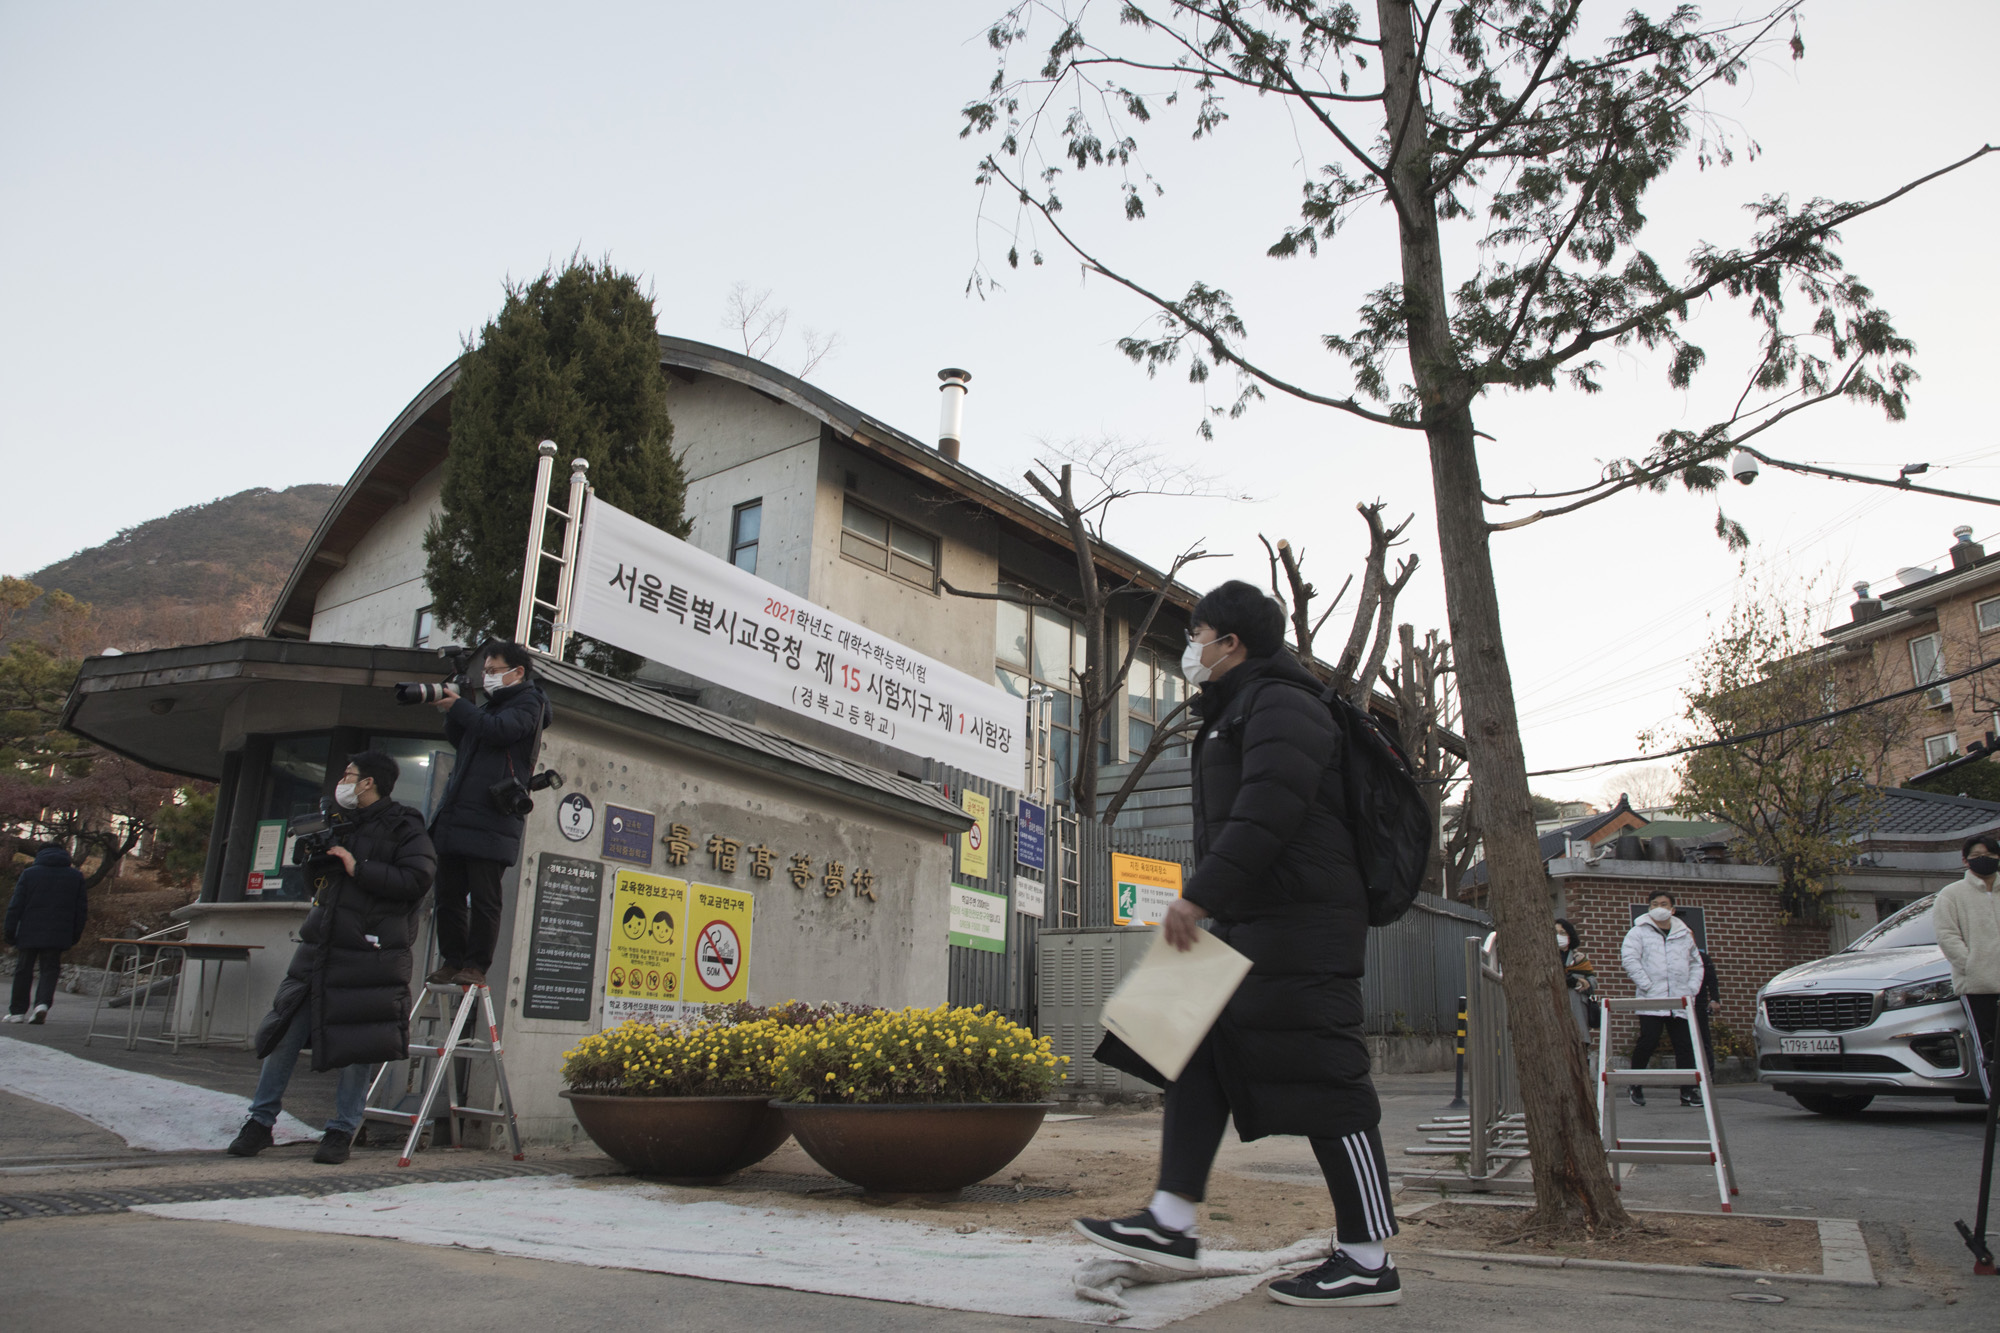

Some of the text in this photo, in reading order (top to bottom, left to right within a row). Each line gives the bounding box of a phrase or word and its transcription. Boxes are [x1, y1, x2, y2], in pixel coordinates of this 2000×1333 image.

[764, 597, 927, 684] 2021학년도 대학수학능력시험
[608, 562, 1012, 754] 서울특별시교육청 제 15 시험지구 제 1 시험장
[572, 812, 580, 826] 9
[1129, 861, 1139, 871] 지진
[620, 880, 683, 902] 교육환경보호구역
[699, 893, 745, 912] 학교금연구역
[706, 966, 720, 976] 50M
[609, 1000, 620, 1009] 학교
